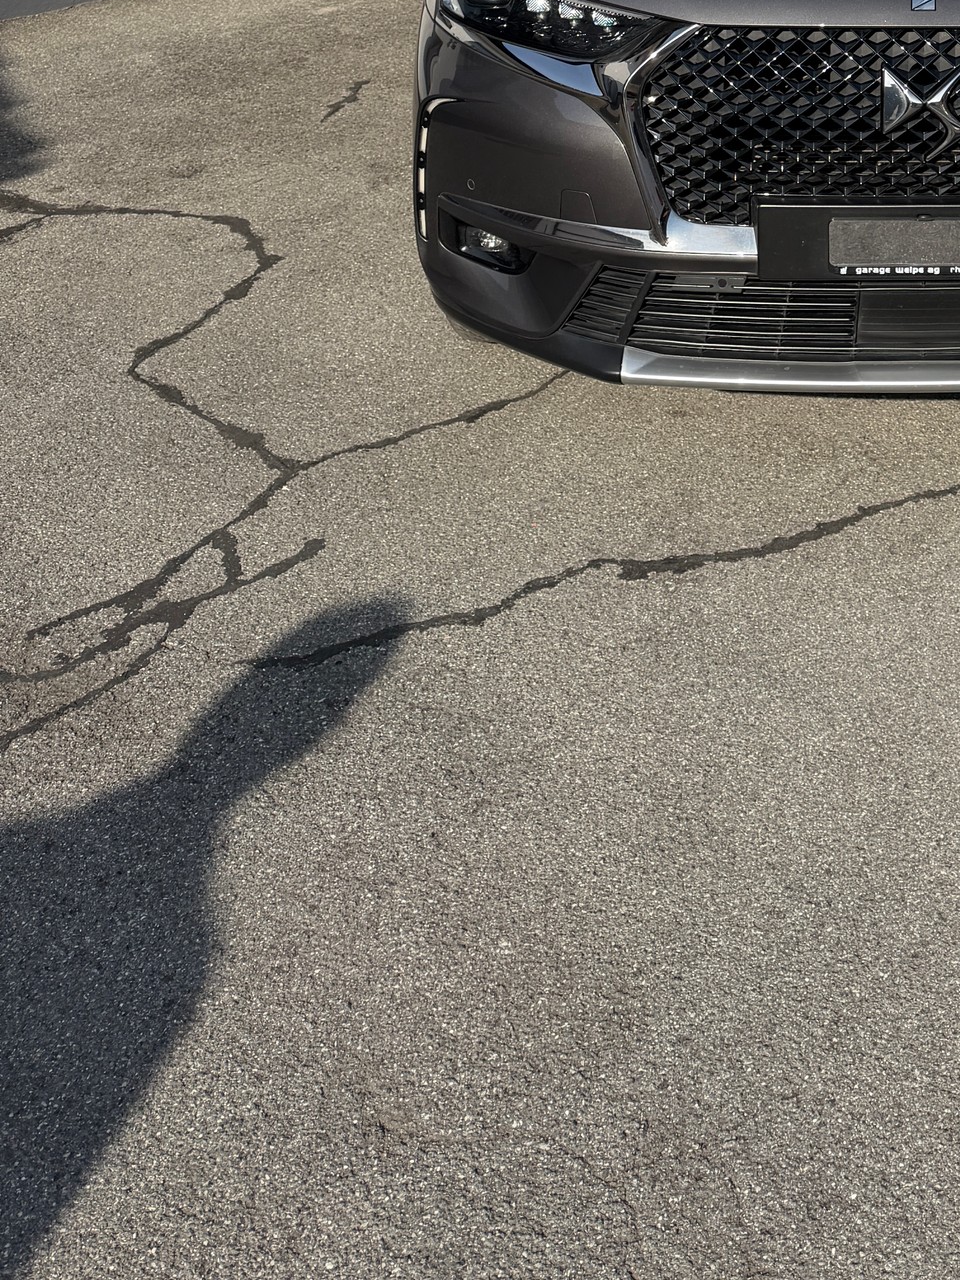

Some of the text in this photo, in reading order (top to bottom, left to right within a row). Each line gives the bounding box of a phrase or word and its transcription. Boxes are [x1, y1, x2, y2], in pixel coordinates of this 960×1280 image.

[855, 267, 891, 275] garage
[895, 266, 924, 275] welpe
[927, 266, 941, 275] ag
